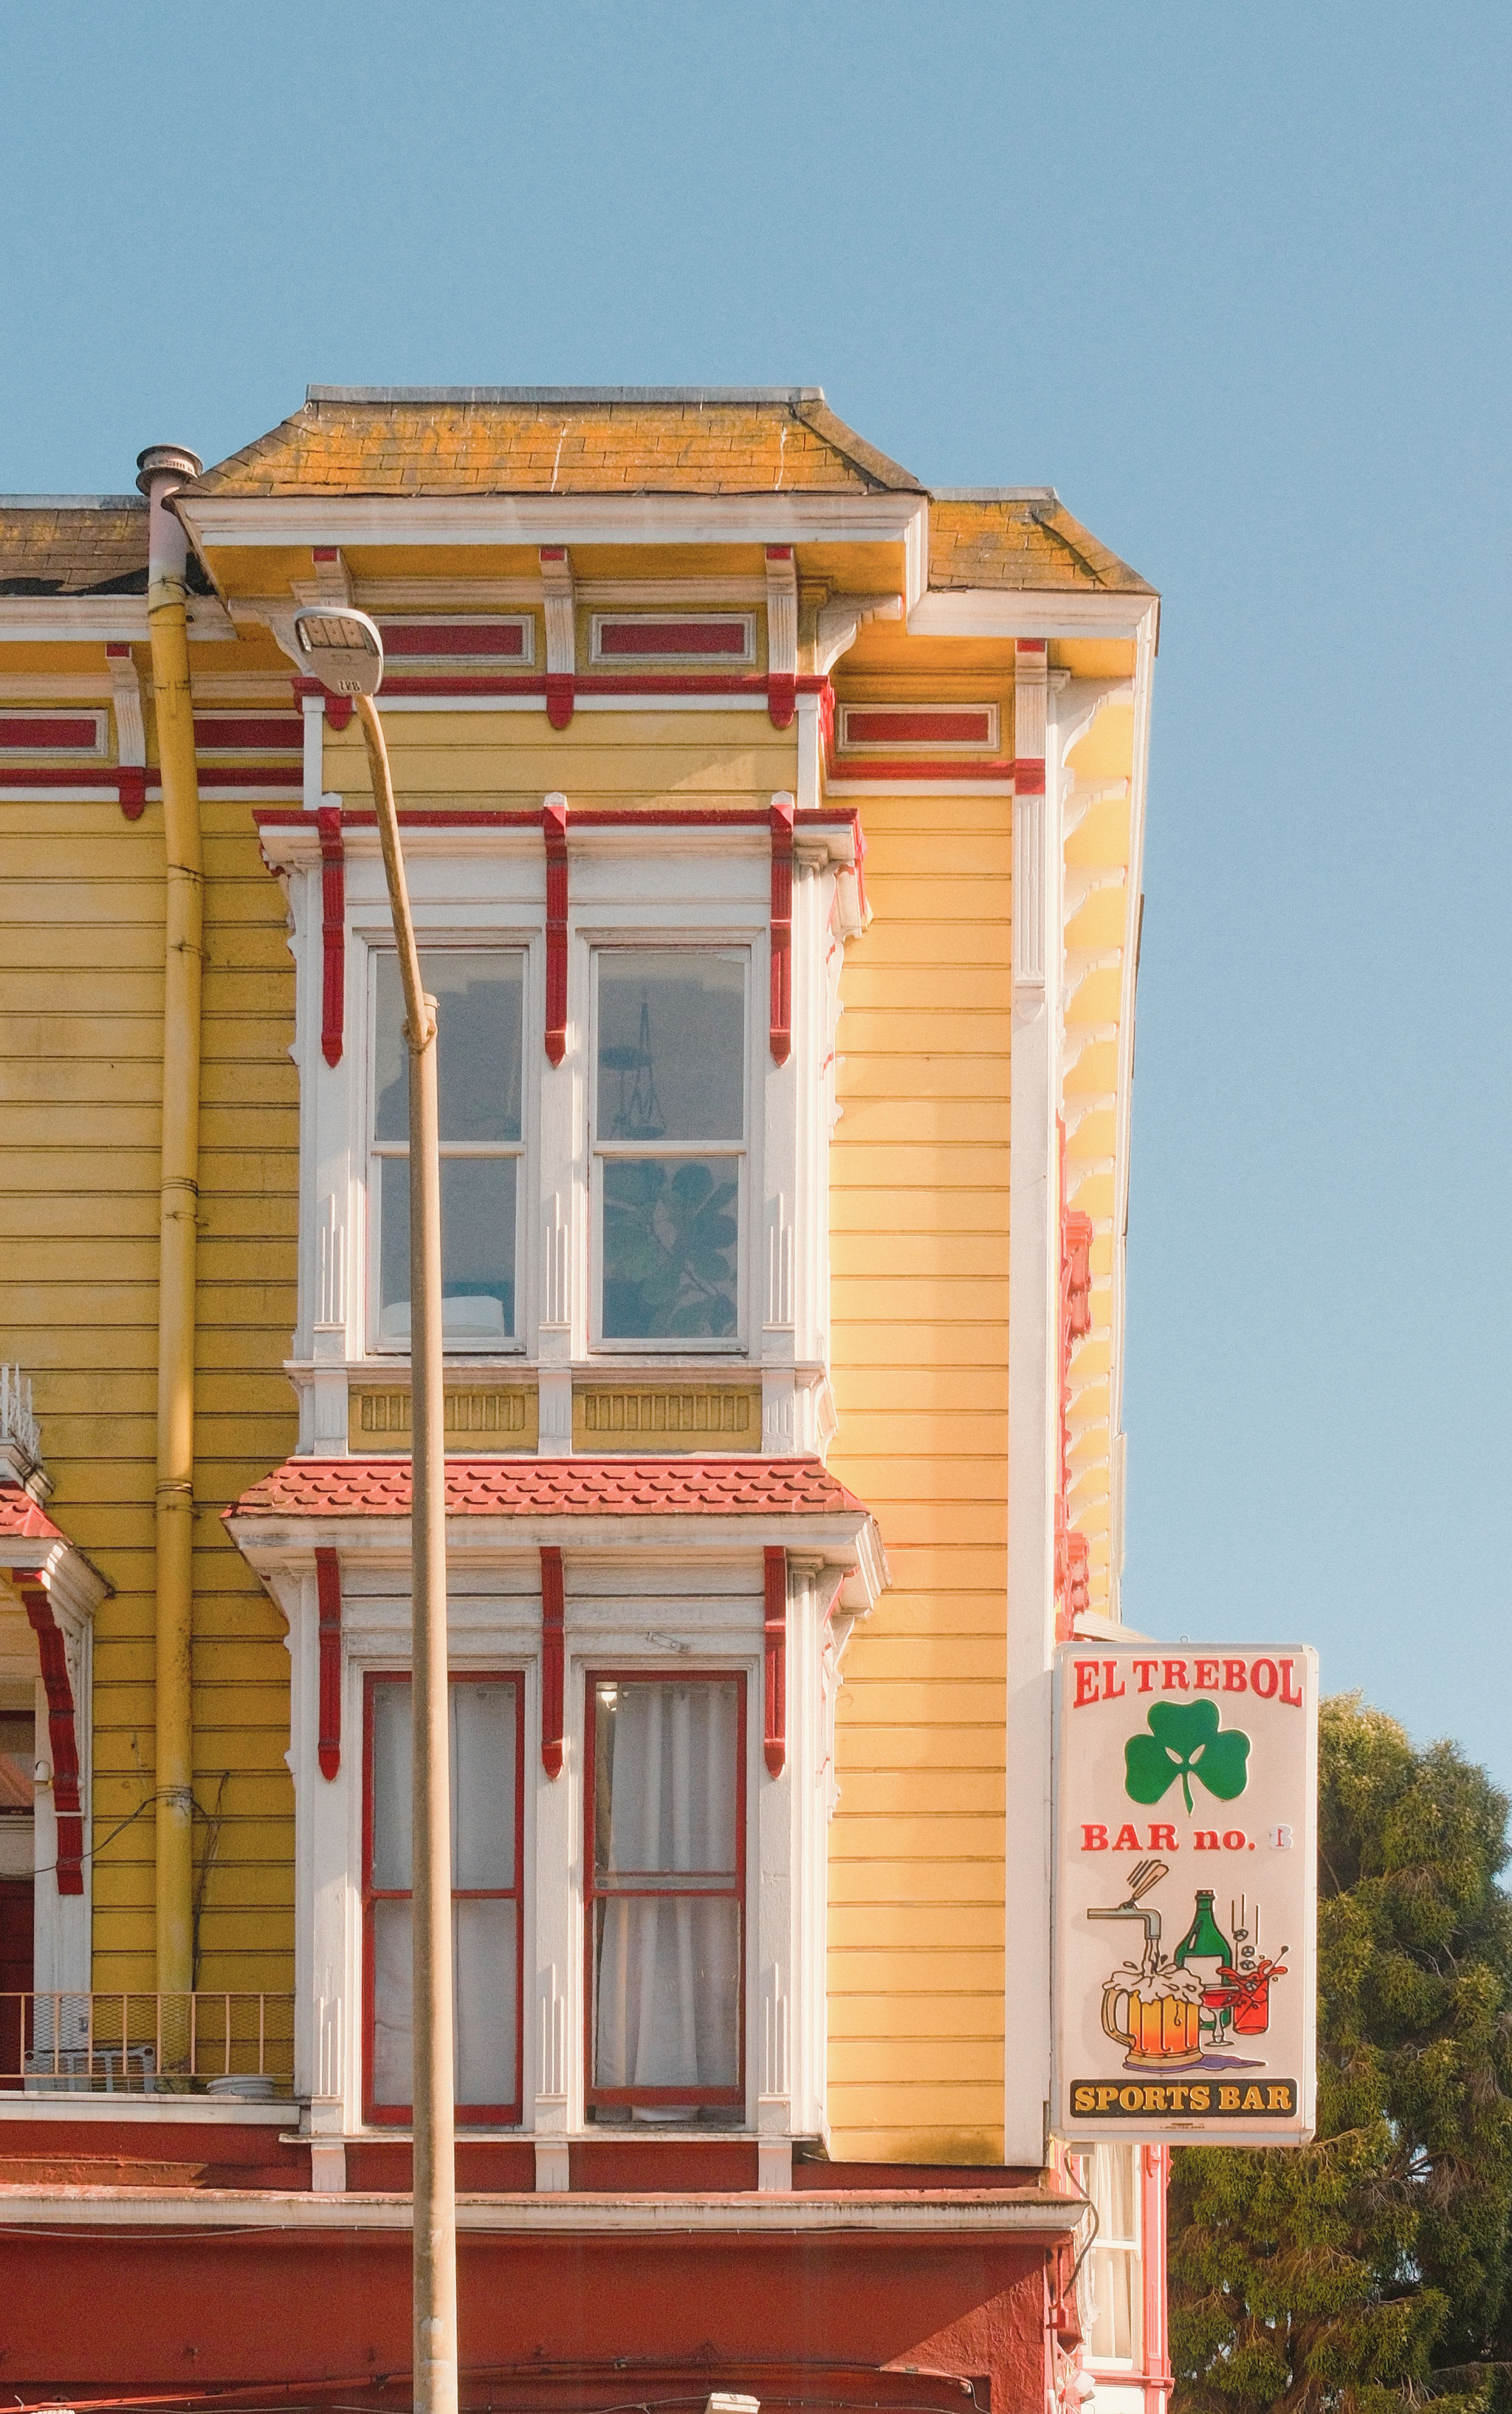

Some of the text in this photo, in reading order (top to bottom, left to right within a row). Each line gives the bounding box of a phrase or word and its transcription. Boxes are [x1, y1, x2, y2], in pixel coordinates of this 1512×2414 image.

[1073, 1658, 1302, 1709] EL TREBOL
[1081, 1824, 1180, 1851] BAR
[1194, 1831, 1255, 1851] no.
[1076, 2086, 1291, 2110] SPORTS BAR
